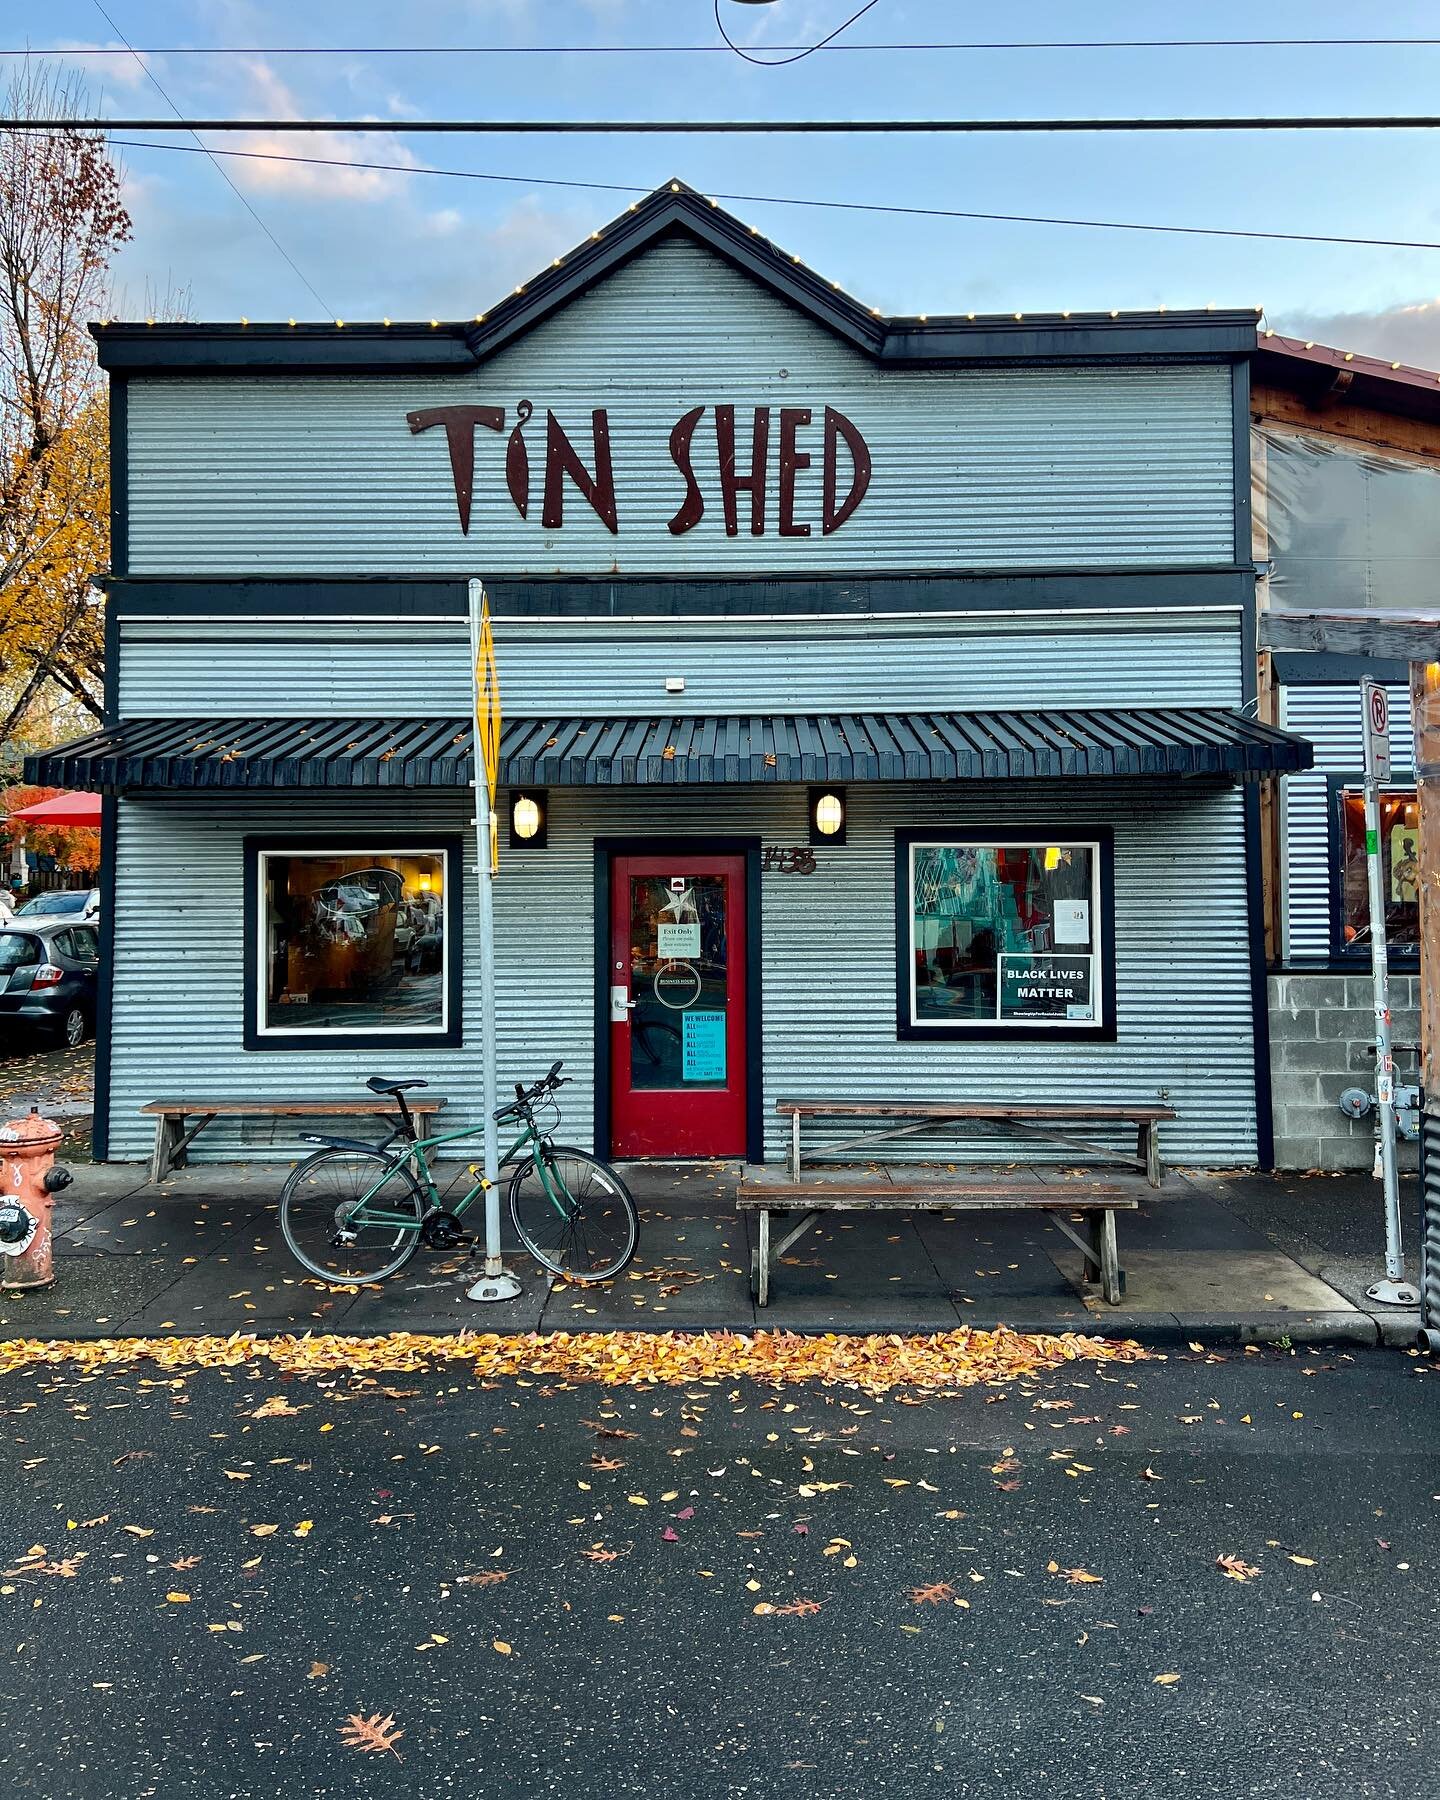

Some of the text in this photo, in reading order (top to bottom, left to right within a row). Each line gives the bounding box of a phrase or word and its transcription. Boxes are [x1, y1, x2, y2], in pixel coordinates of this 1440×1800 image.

[667, 404, 872, 536] SHED
[763, 846, 816, 875] 1438
[1007, 970, 1084, 979] BLACK LIVES
[1017, 988, 1074, 998] MATTER
